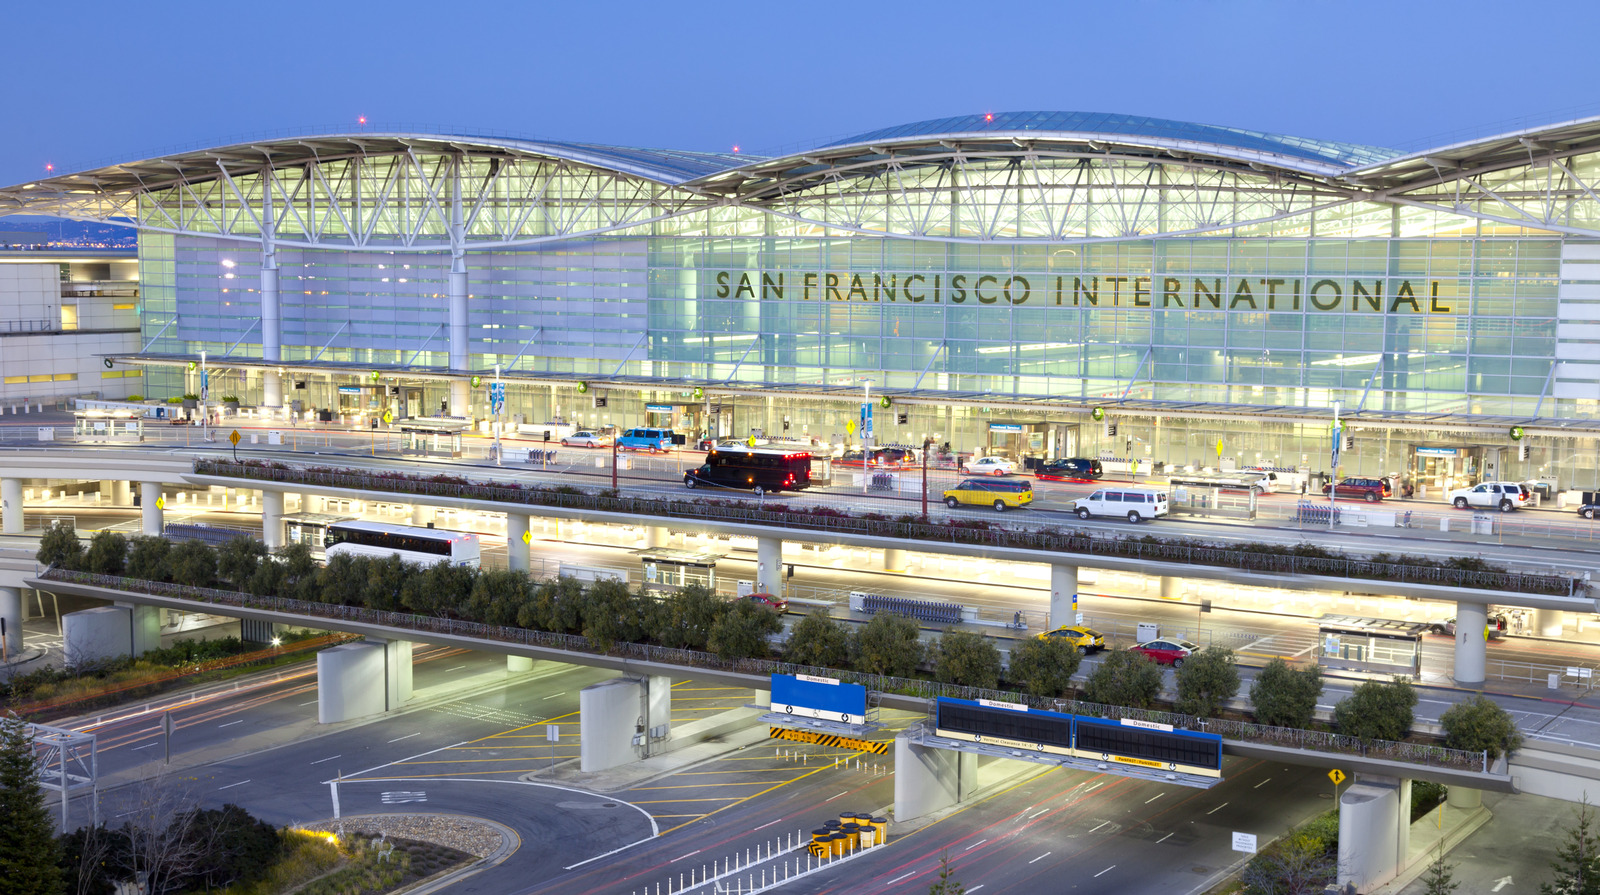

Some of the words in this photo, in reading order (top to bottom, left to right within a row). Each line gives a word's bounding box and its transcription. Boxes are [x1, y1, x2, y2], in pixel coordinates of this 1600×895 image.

[716, 271, 784, 300] SAN
[803, 272, 1031, 304] FRANCISCO
[1056, 276, 1451, 312] INTERNATIONAL
[1133, 720, 1160, 729] Domestic
